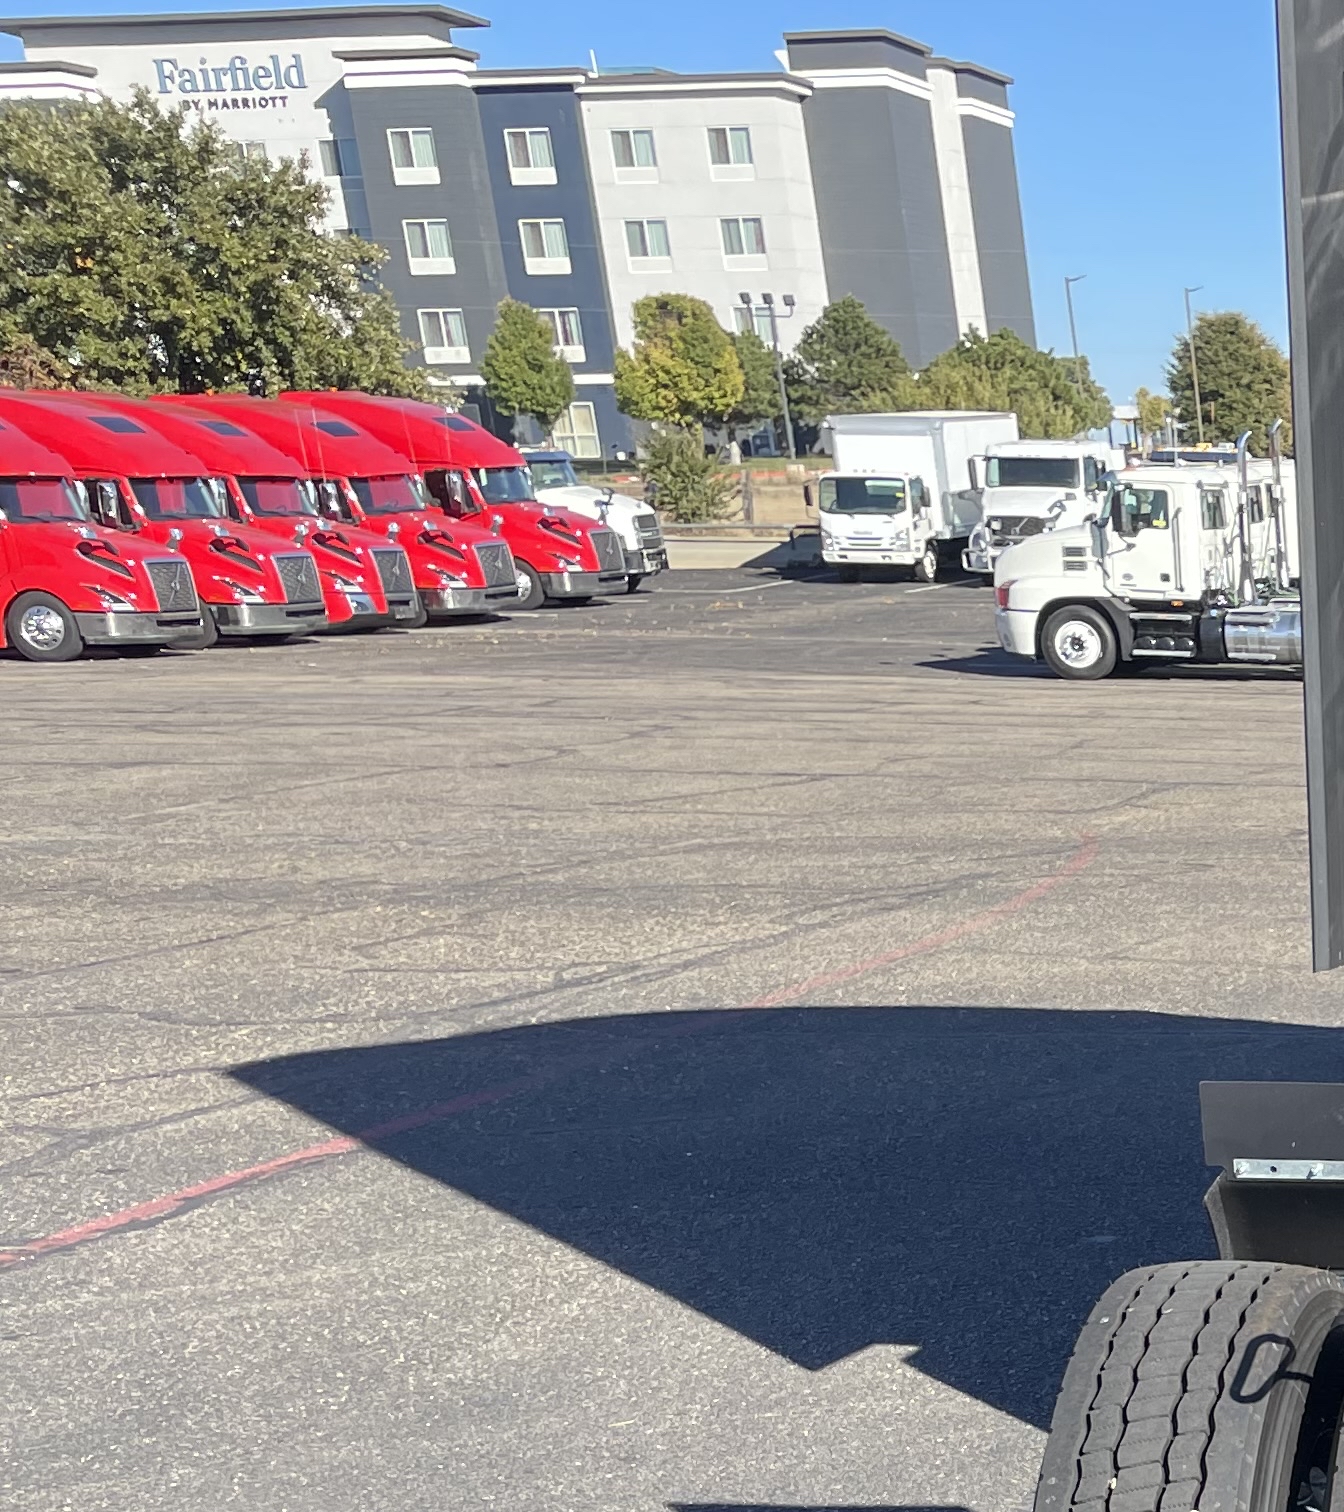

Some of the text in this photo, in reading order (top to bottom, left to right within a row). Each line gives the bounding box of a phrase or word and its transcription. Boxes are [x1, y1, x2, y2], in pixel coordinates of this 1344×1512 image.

[153, 54, 308, 94] Fairfield
[182, 96, 289, 111] BY MARRIOTT
